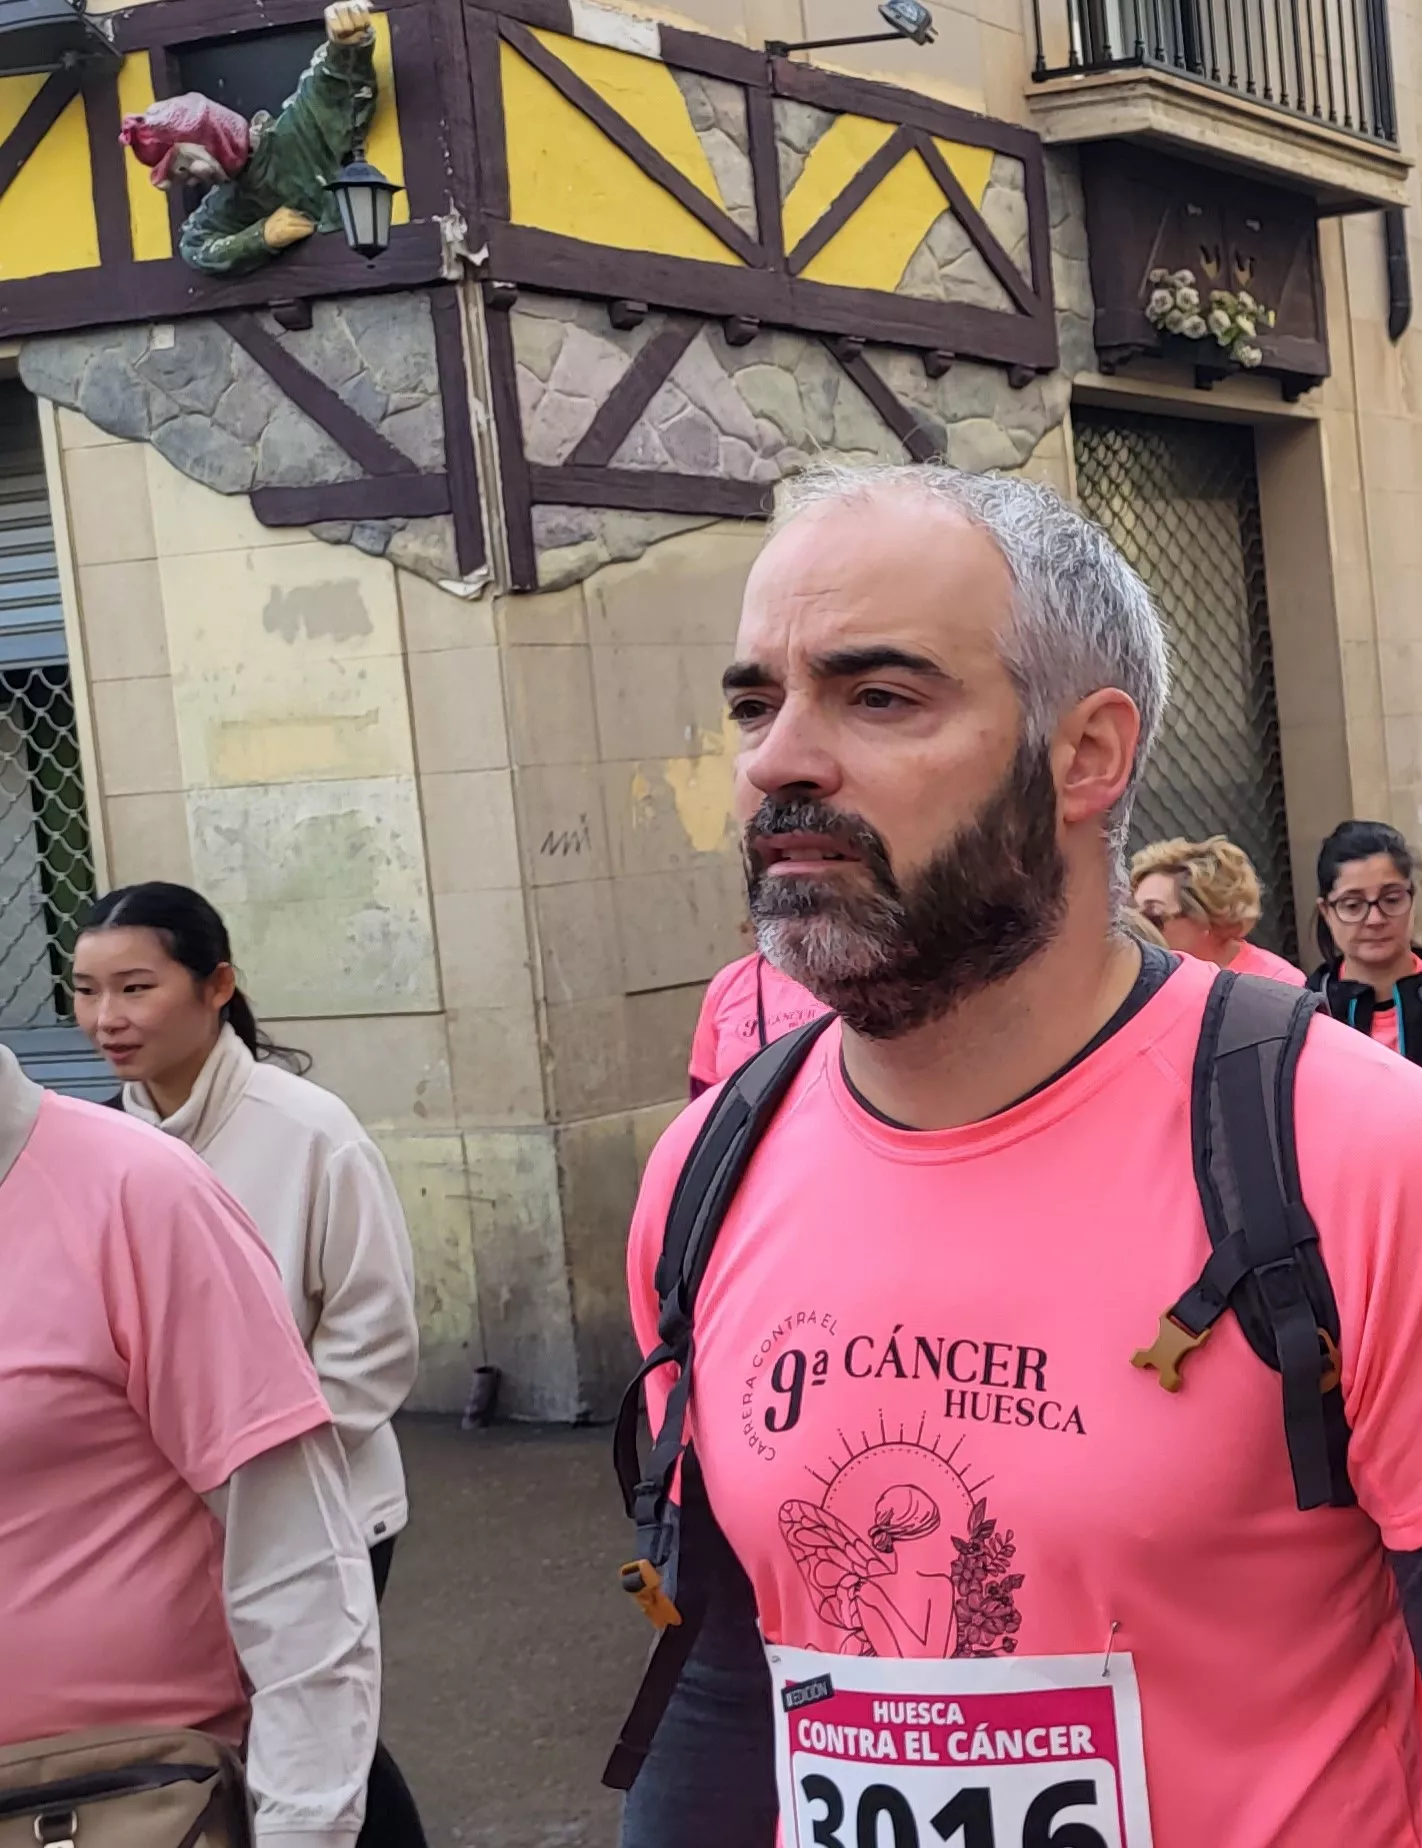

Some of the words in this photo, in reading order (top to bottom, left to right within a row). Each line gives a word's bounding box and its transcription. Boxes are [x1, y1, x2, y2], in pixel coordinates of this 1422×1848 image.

[844, 1324, 1048, 1392] CÁNCER
[943, 1388, 1087, 1435] HUESCA
[873, 1700, 965, 1725] HUESCA
[798, 1719, 899, 1760] CONTRA
[905, 1731, 939, 1761] EL
[948, 1723, 1096, 1760] CÁNCER
[800, 1773, 1109, 1848] 3016
